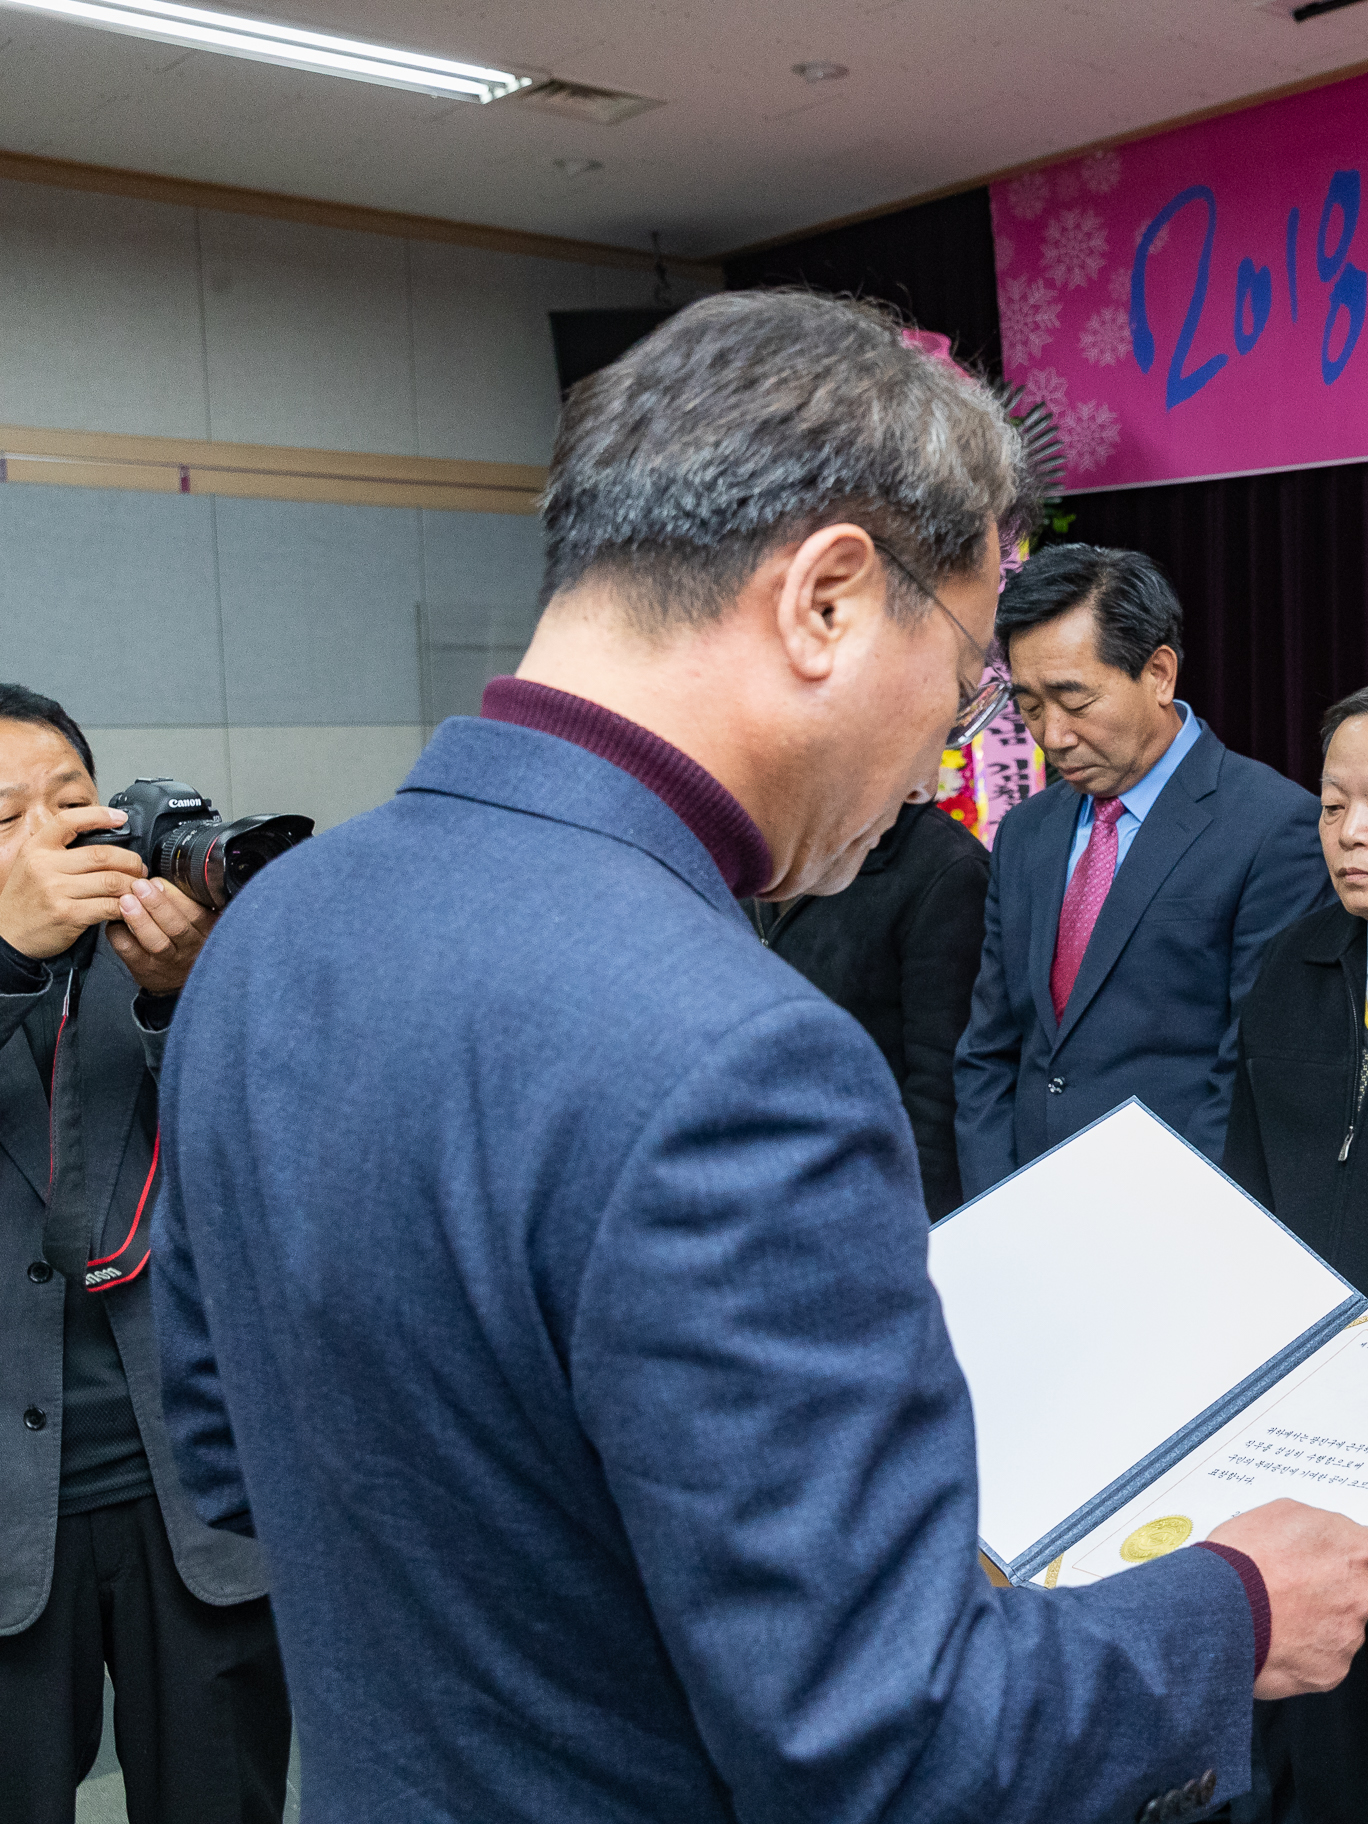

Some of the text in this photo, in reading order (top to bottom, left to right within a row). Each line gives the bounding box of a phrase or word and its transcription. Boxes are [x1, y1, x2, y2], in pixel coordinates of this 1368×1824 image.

[1129, 168, 1368, 410] 2018
[168, 798, 202, 808] Canon
[1245, 1439, 1274, 1453] 직무를
[1228, 1453, 1255, 1466] 구민의
